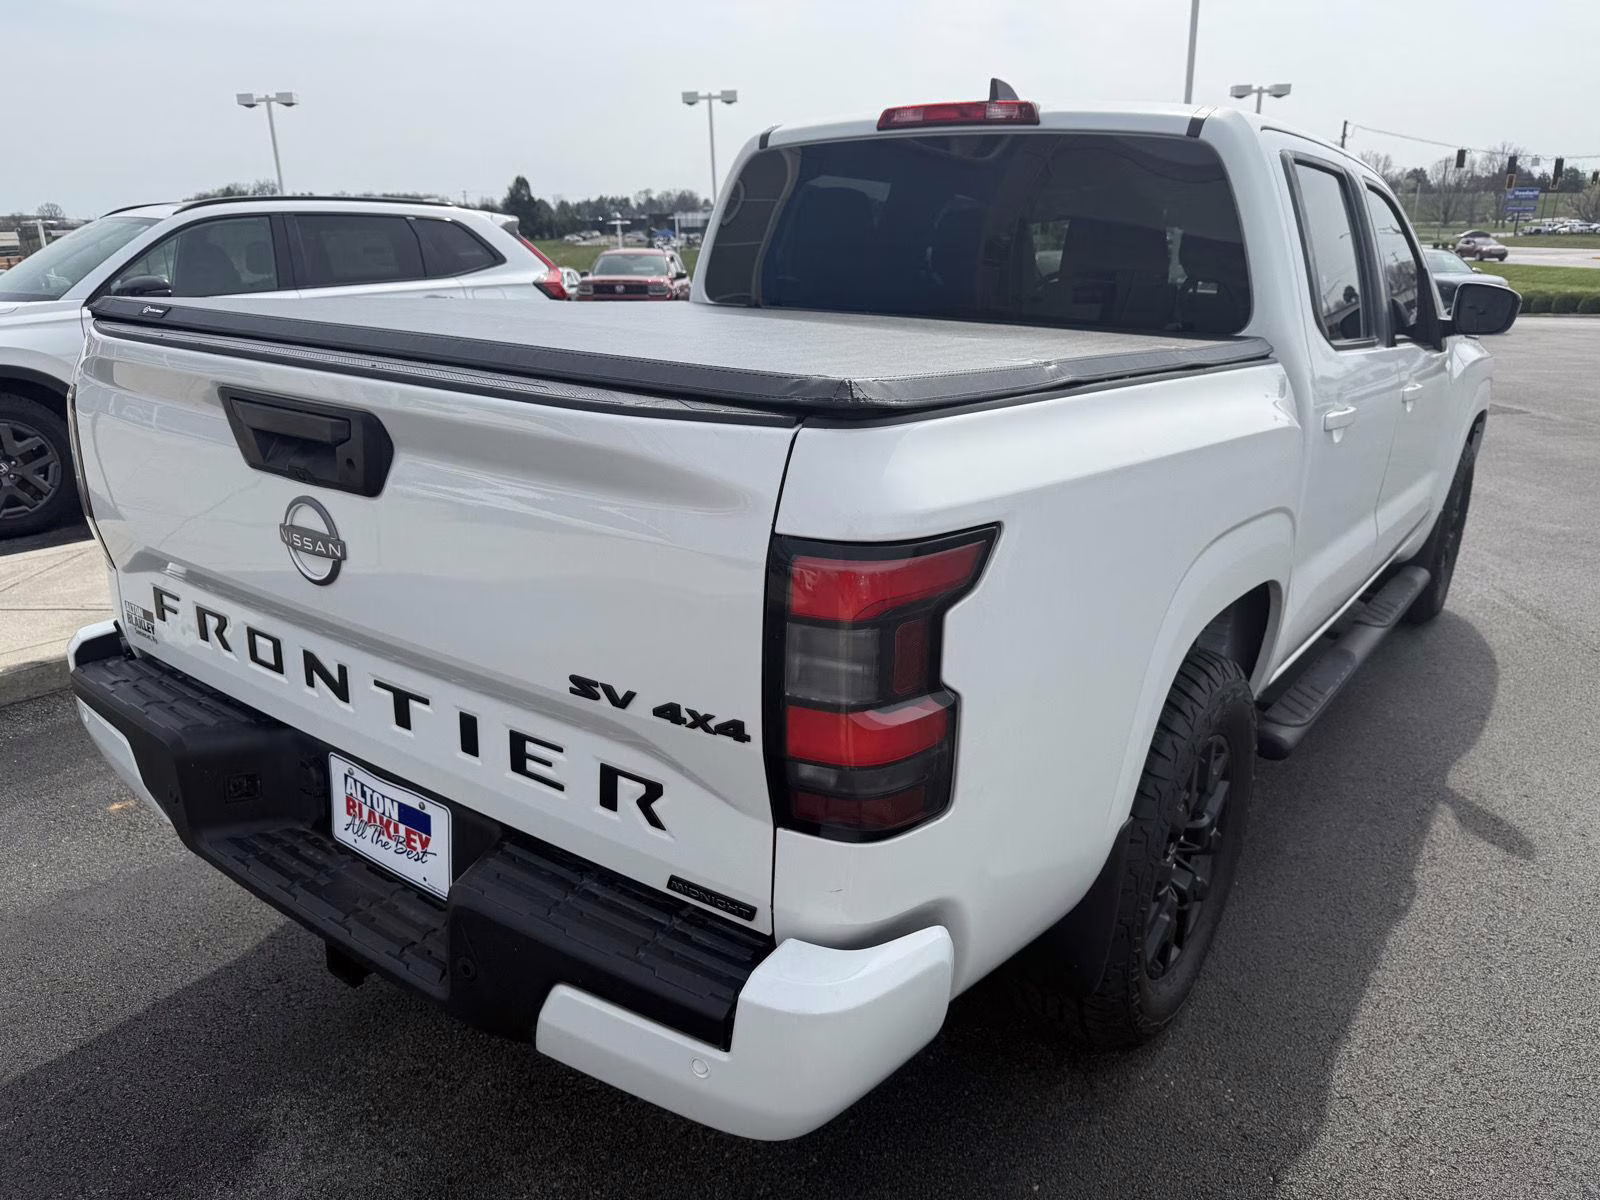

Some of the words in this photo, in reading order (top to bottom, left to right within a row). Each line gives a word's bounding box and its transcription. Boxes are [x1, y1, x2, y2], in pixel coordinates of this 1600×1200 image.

[280, 526, 342, 557] NISSAN
[152, 585, 668, 832] FRONTIER
[569, 674, 637, 710] SV
[345, 774, 400, 822] ALTON
[344, 815, 368, 840] All
[367, 824, 392, 851] The
[393, 834, 438, 864] Best
[345, 795, 432, 851] BLAKLEY
[671, 880, 751, 918] MIDNIGHT
